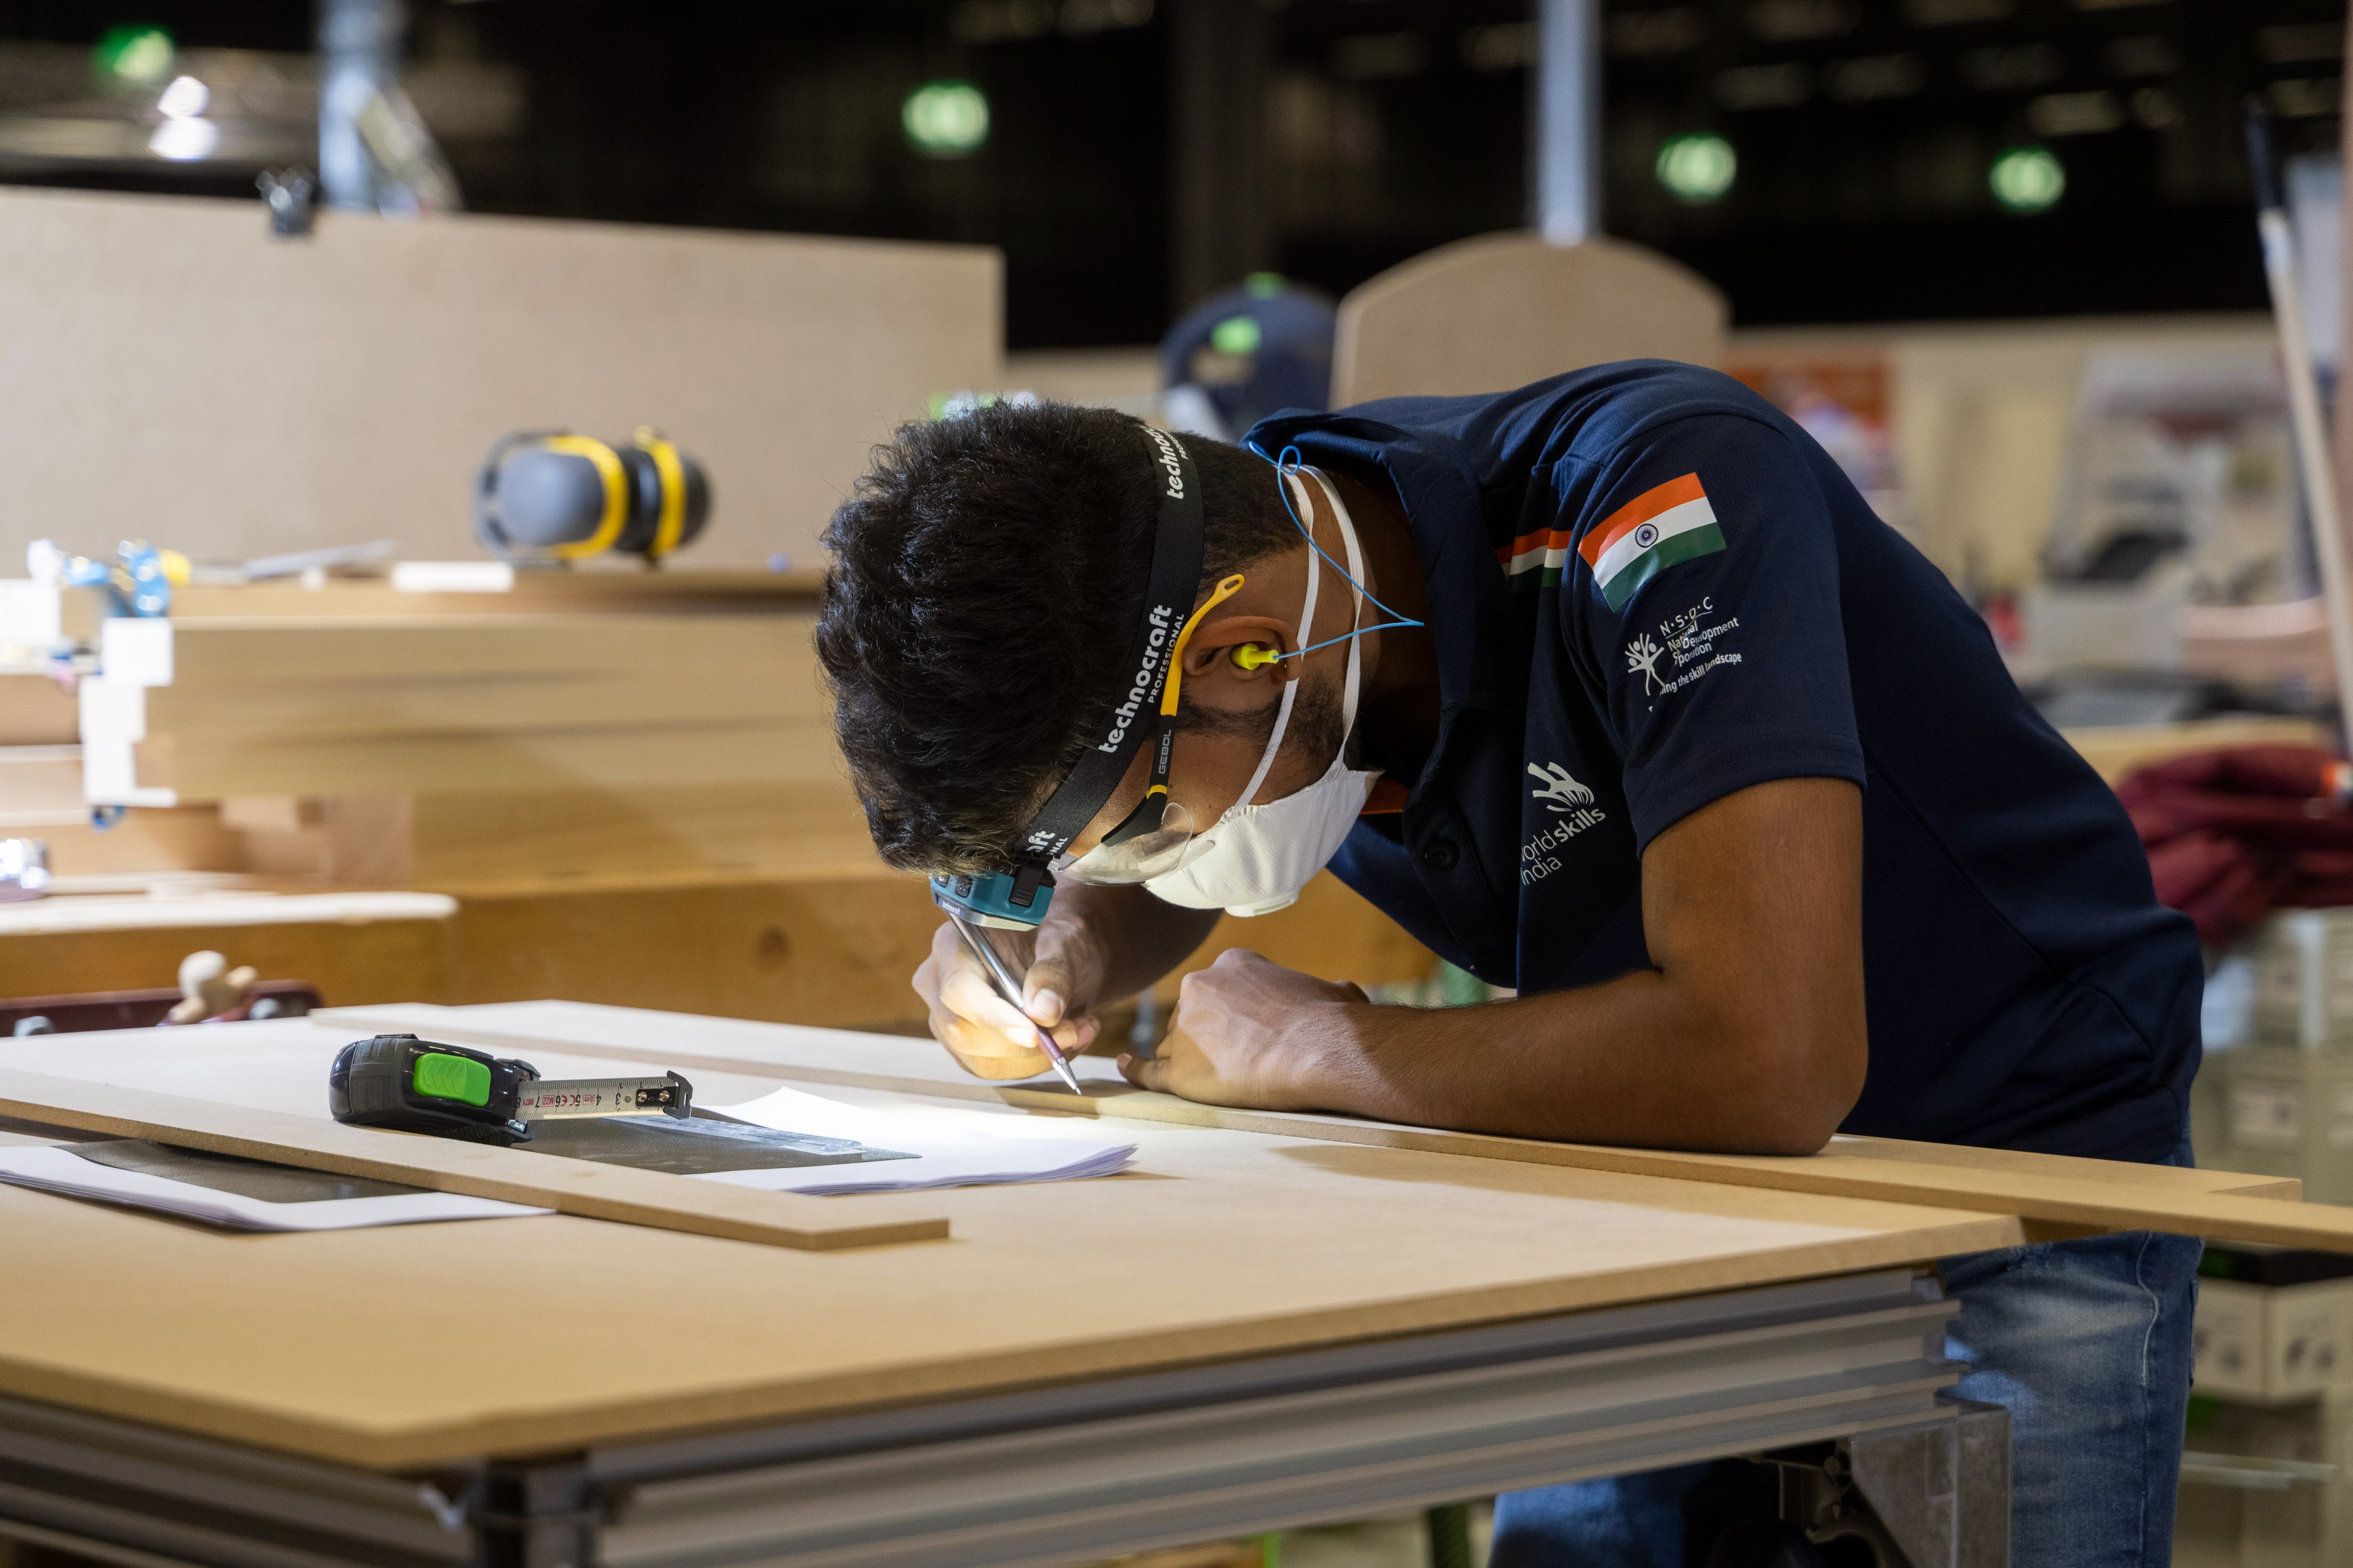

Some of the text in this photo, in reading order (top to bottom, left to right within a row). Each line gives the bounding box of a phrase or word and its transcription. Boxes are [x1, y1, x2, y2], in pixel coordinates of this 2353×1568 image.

[1148, 614, 1184, 703] PROFESSIONAL
[1678, 673, 1690, 686] the
[1689, 665, 1706, 682] skill
[1706, 653, 1742, 671] landscape
[1098, 605, 1172, 753] technocraft
[1158, 729, 1172, 774] GEBOL
[535, 1096, 540, 1108] 7
[555, 1096, 561, 1107] 6
[575, 1095, 581, 1106] 5
[596, 1094, 601, 1106] 4
[615, 1093, 621, 1105] 3
